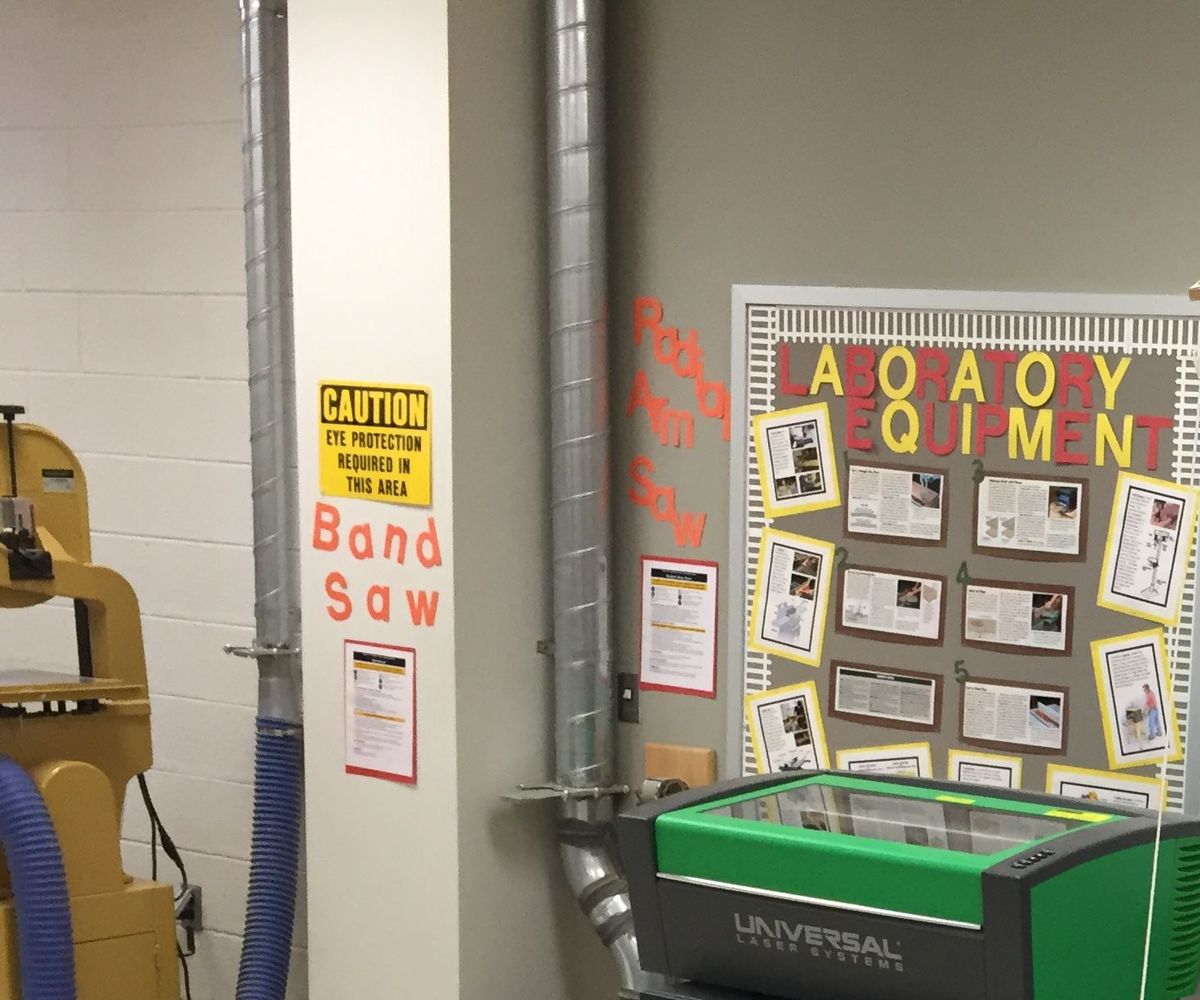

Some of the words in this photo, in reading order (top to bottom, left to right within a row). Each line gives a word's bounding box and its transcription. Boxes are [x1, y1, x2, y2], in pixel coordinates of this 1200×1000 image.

[778, 343, 1132, 411] LABORATORY
[322, 387, 427, 428] CAUTION
[626, 368, 694, 449] Arm
[844, 397, 1173, 470] EQUIPMENT
[326, 430, 346, 447] EYE
[351, 432, 422, 453] PROTECTION
[337, 453, 393, 474] REQUIRED
[398, 457, 411, 474] IN
[346, 476, 372, 495] THIS
[378, 480, 408, 498] AREA
[627, 456, 708, 548] Saw
[312, 502, 442, 569] Band
[324, 571, 440, 628] Saw
[734, 913, 903, 961] UNIVERSAL
[737, 934, 798, 953] LASER
[810, 947, 904, 972] SYSTEMS
